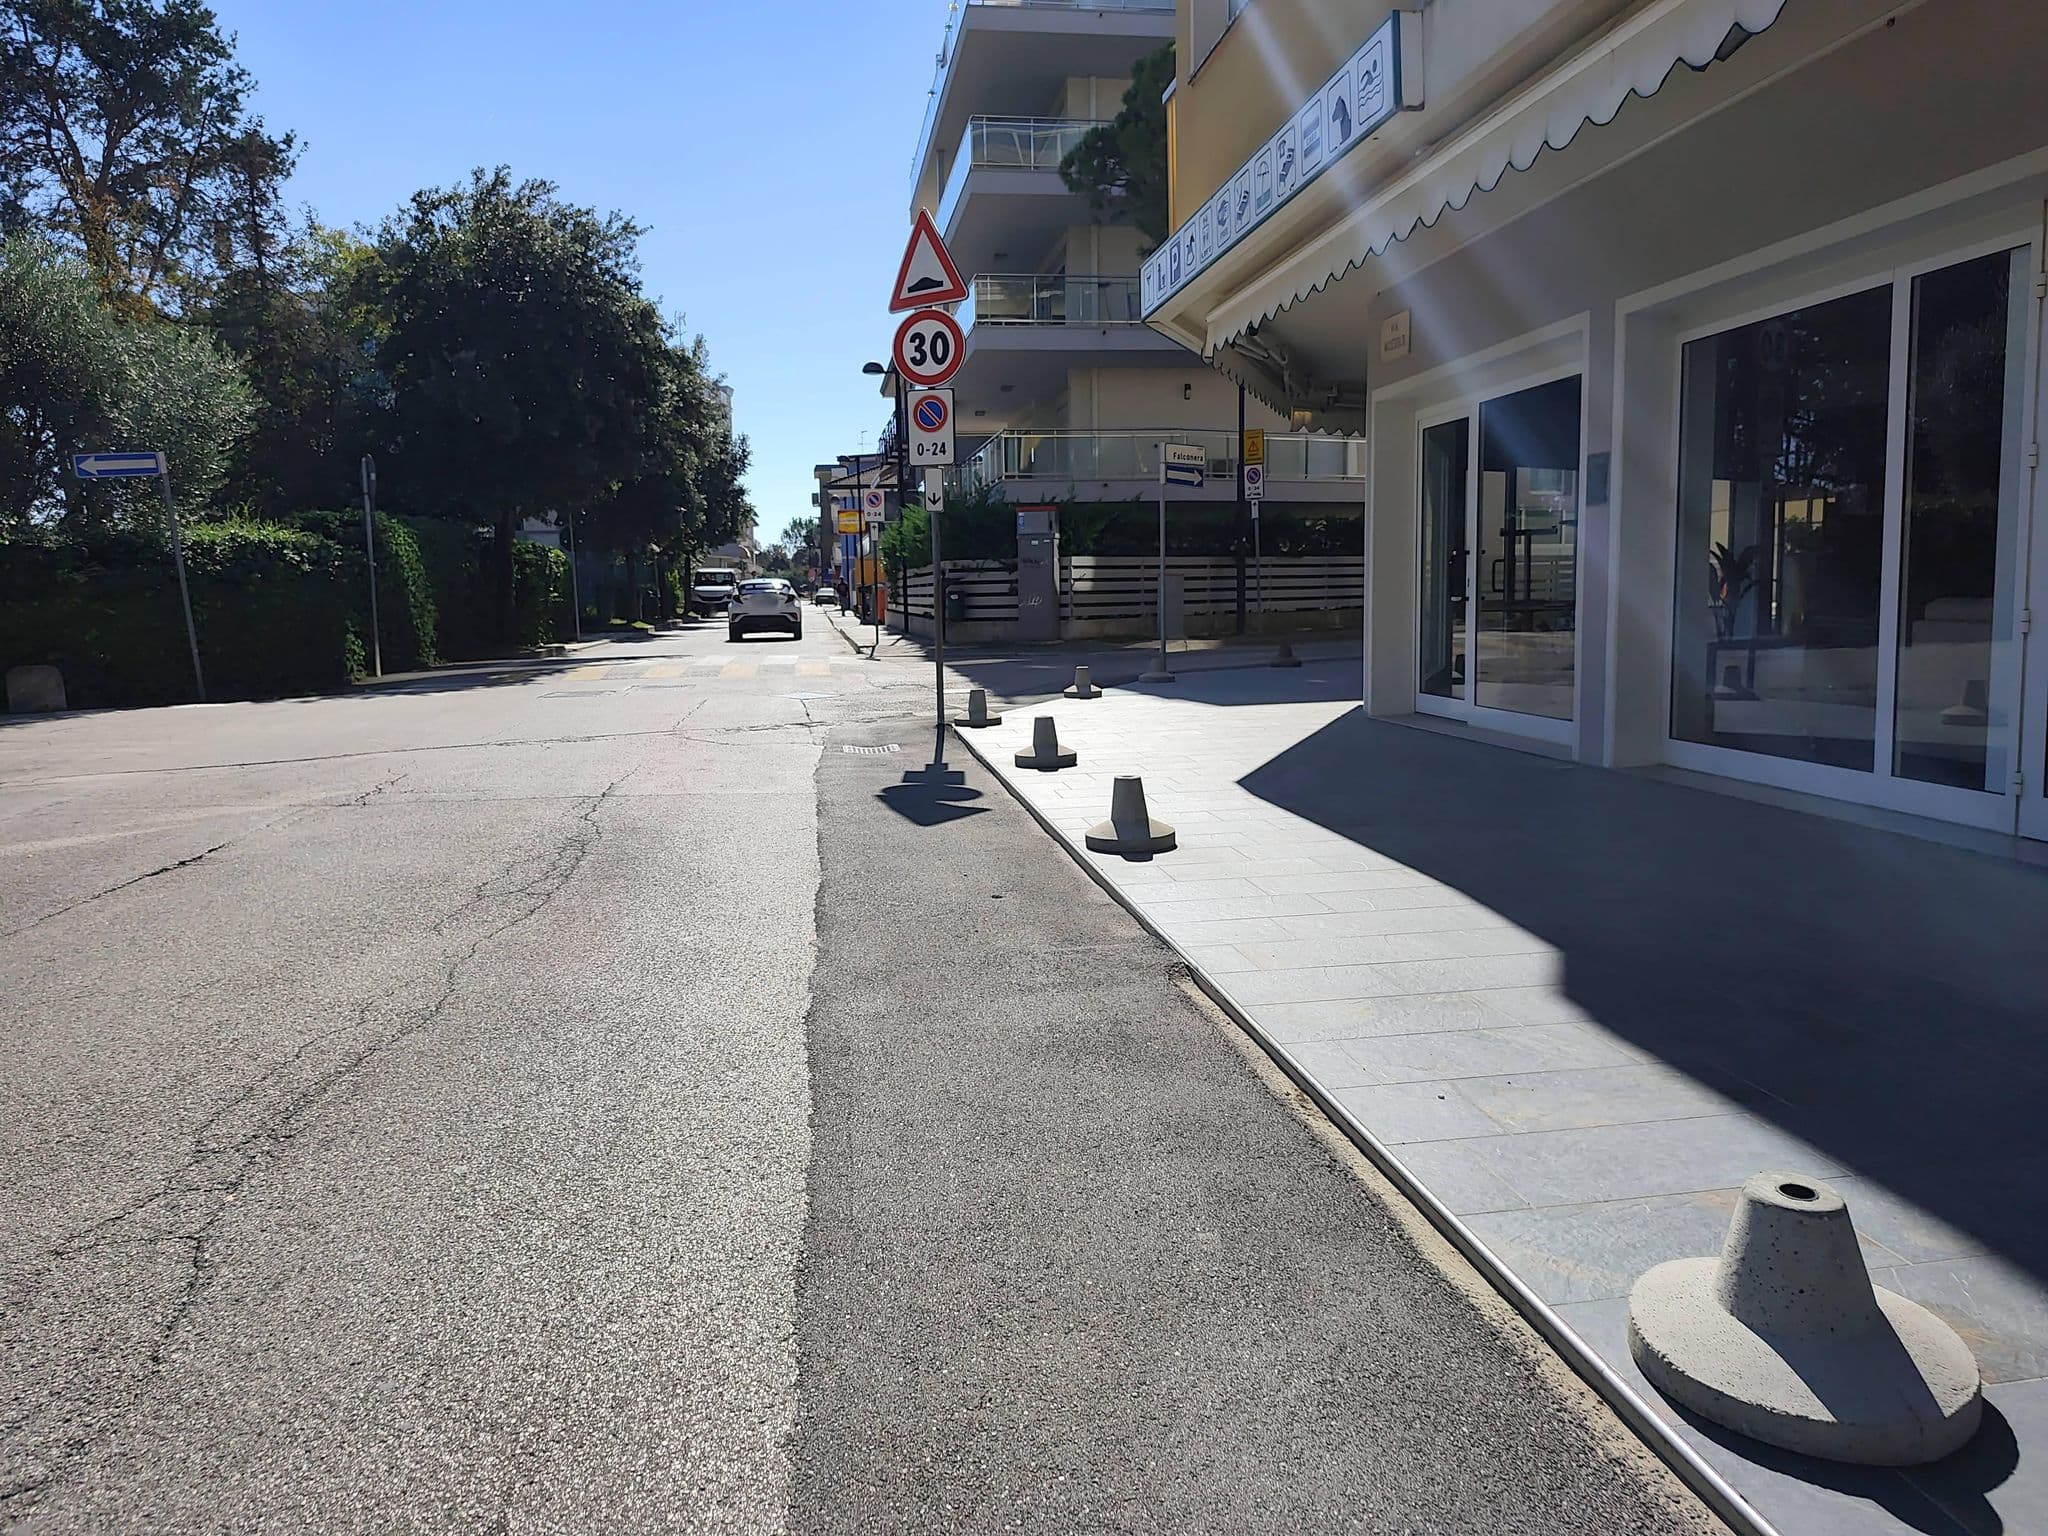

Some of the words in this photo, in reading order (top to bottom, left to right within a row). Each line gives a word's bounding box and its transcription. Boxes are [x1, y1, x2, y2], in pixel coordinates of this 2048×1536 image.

[909, 331, 950, 366] 30
[917, 442, 946, 456] 0-24
[1173, 451, 1204, 462] Falconera
